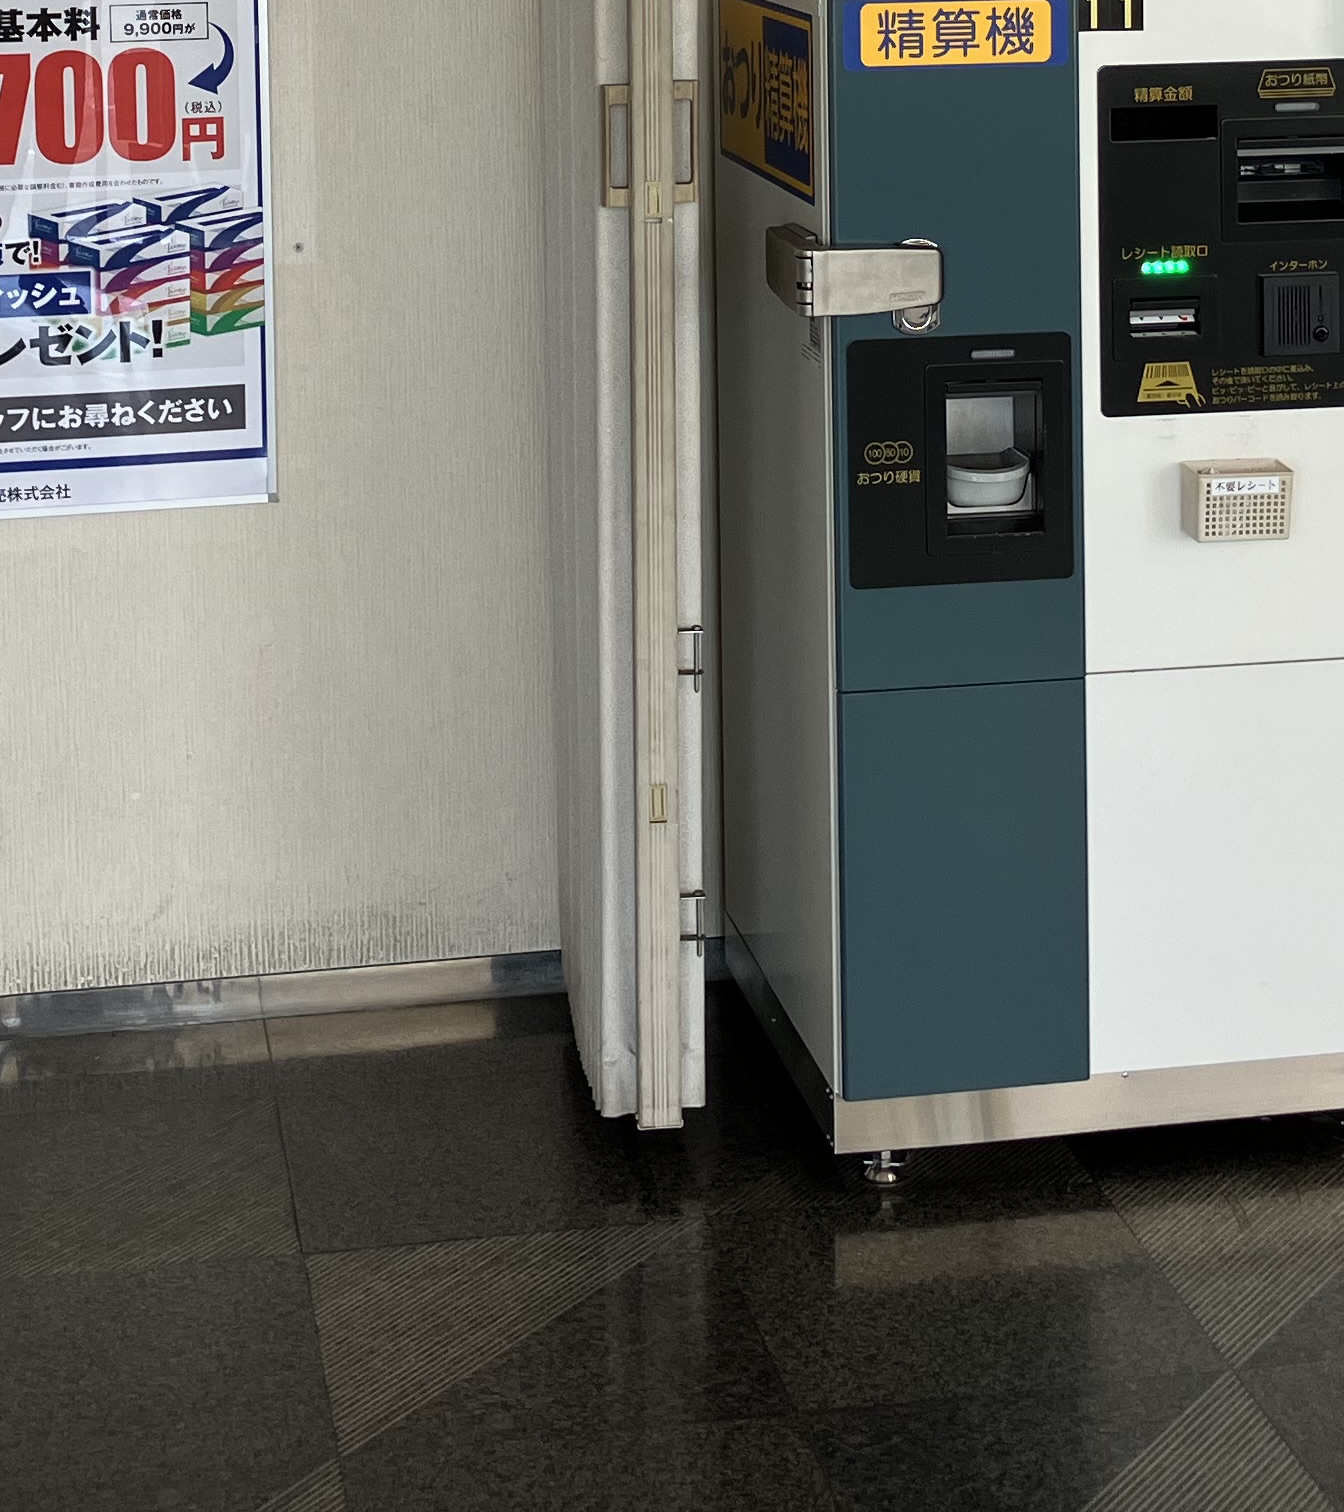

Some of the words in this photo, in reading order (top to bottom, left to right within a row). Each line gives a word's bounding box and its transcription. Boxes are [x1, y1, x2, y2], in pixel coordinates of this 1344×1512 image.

[134, 8, 184, 22] 通常価格
[122, 20, 196, 38] 9,900円が
[876, 6, 1035, 60] 精算機
[1264, 73, 1329, 87] おつり紙幣
[1133, 85, 1193, 103] 精算金額
[183, 100, 223, 115] (税込)
[182, 117, 225, 162] 円
[1121, 245, 1208, 260] レシート読取口
[1269, 259, 1328, 271] インターホン
[868, 448, 883, 458] 100
[899, 447, 910, 457] 10
[856, 469, 922, 486] おつり硬貨
[1214, 478, 1277, 493] 不要レシート
